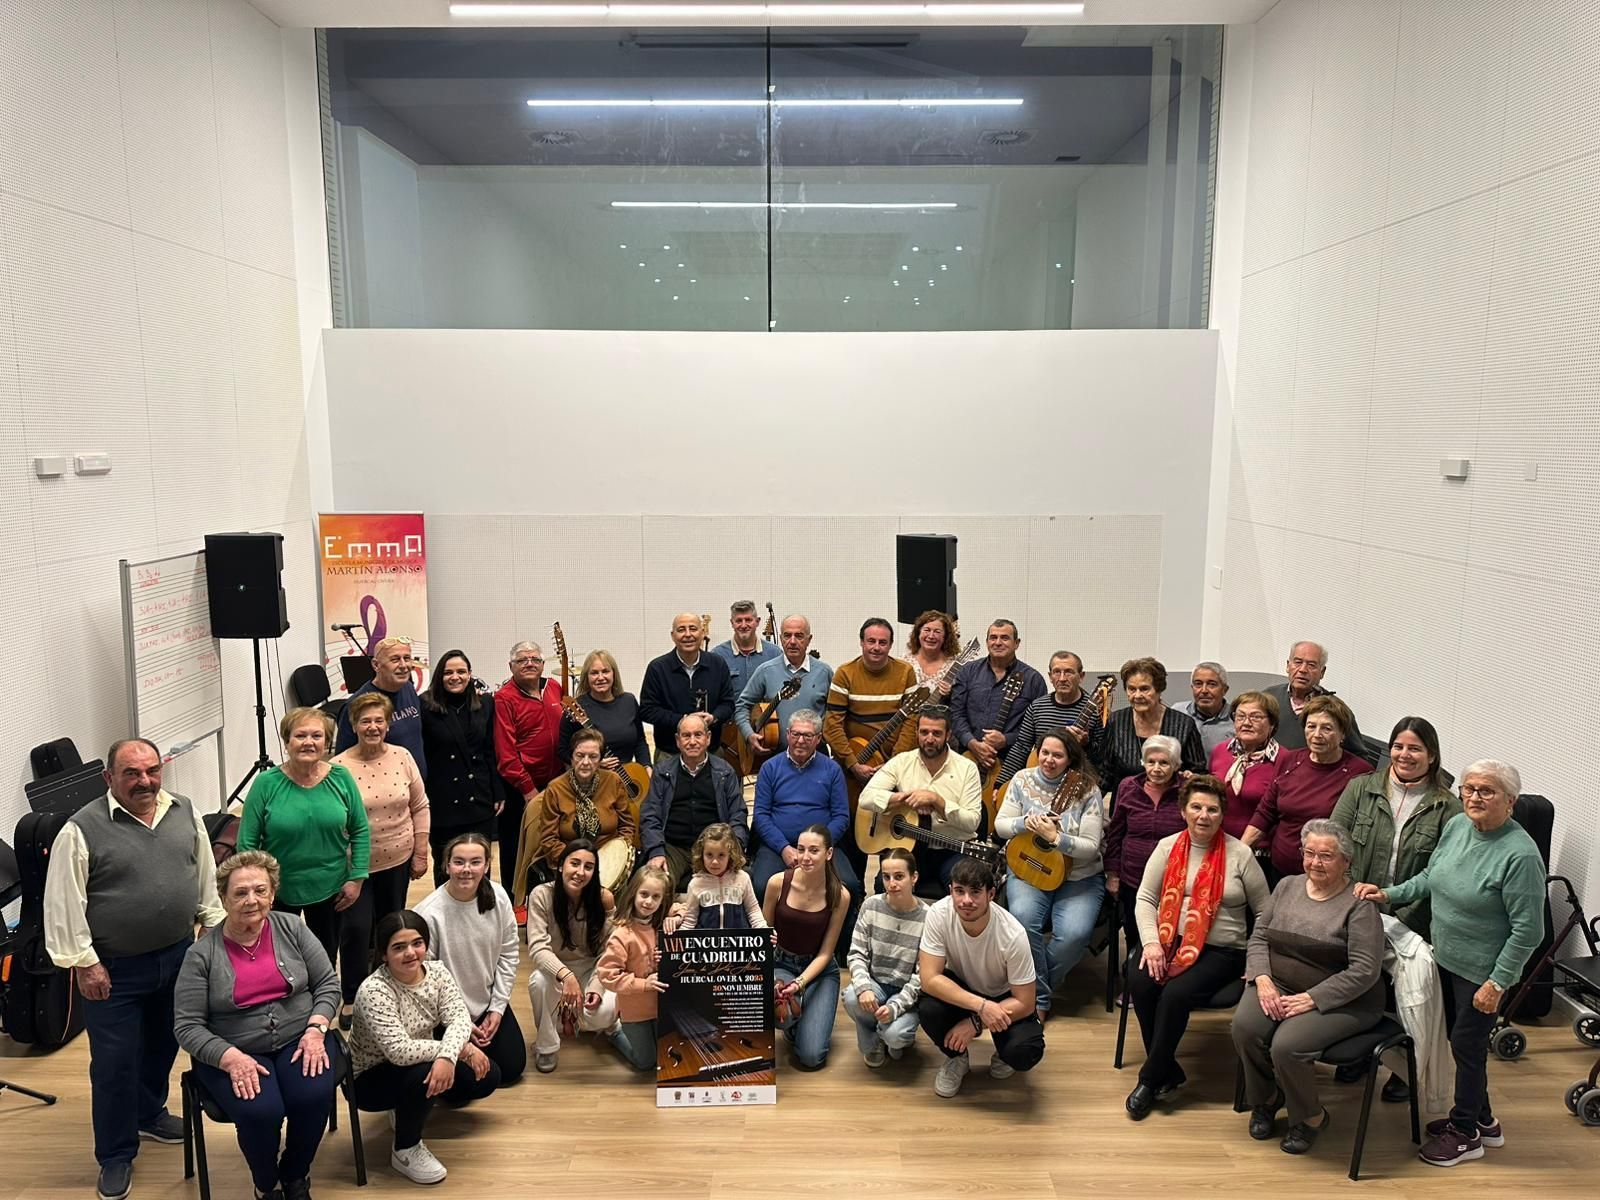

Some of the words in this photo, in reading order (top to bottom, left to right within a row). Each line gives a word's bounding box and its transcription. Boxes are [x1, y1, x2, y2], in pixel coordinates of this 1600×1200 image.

[327, 565, 372, 575] MARTÍN
[376, 565, 423, 574] ALONSO
[392, 706, 418, 721] ILANO
[685, 936, 764, 949] ENCUENTRO
[670, 953, 681, 961] DE
[682, 951, 766, 964] CUADRILLAS
[717, 975, 743, 983] OVERA
